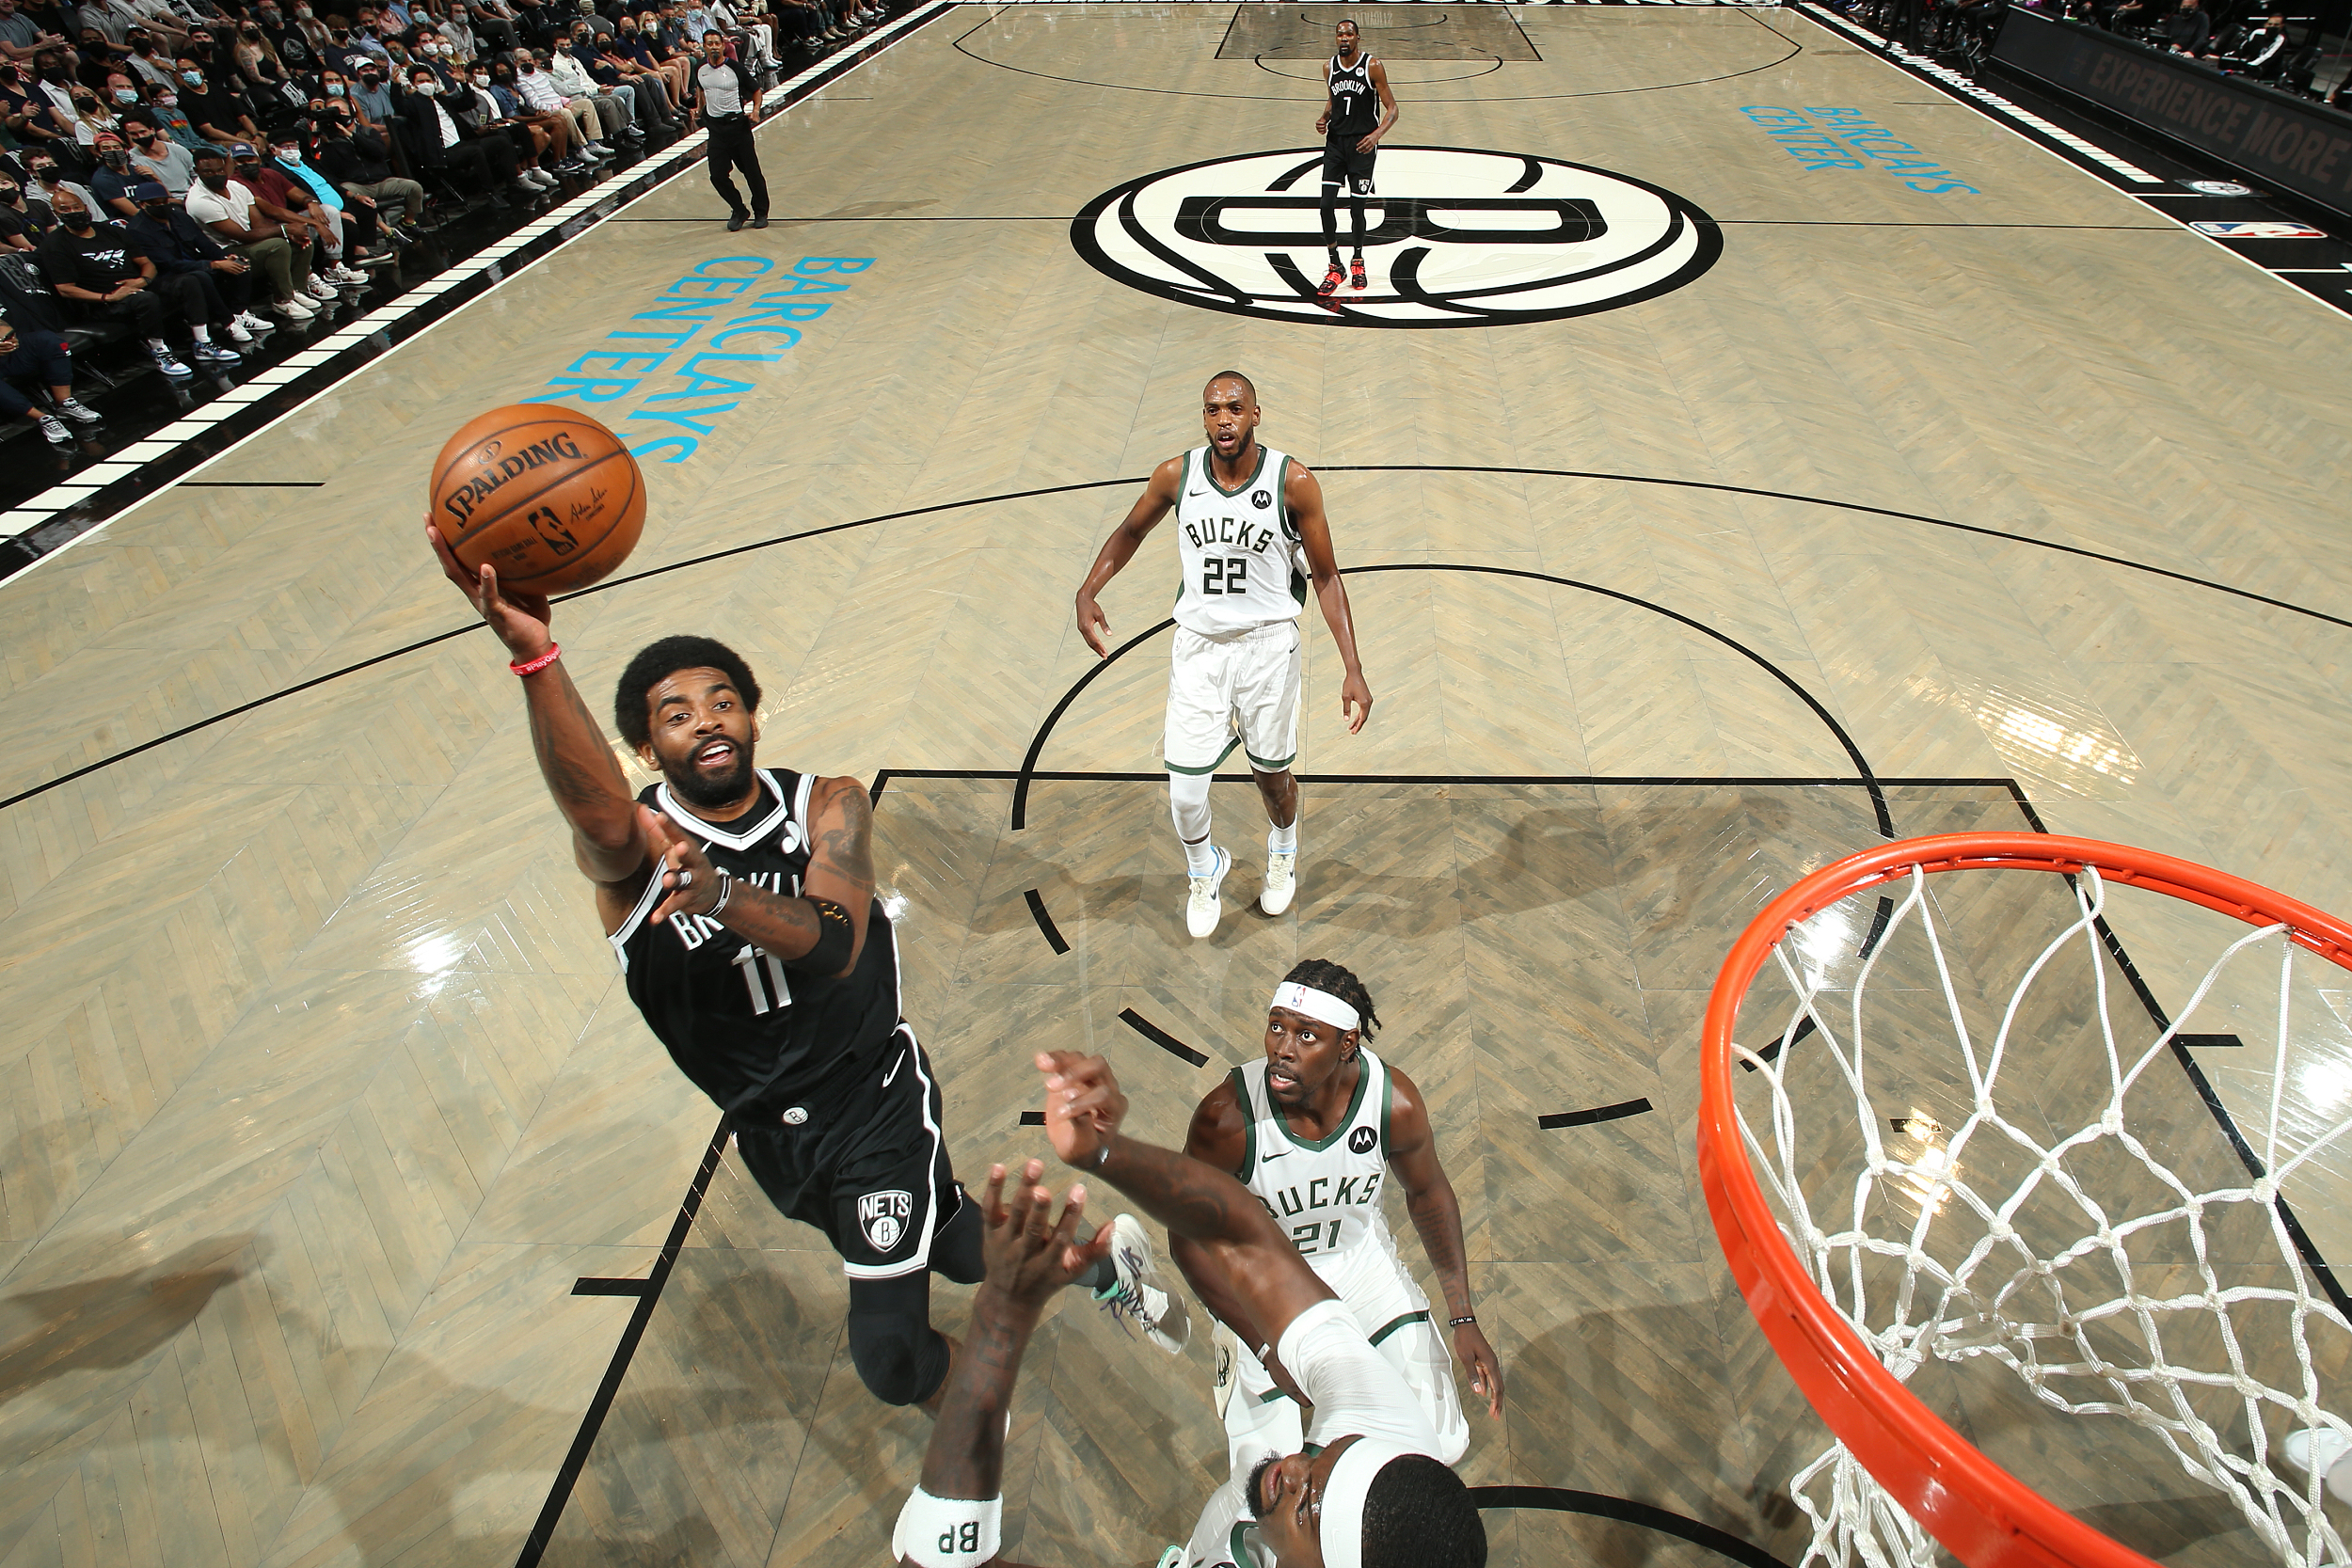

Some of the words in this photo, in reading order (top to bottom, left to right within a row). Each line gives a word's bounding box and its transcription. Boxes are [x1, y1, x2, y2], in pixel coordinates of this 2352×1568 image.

[1331, 79, 1366, 96] BROOKLYN
[1343, 96, 1352, 116] 7
[2089, 53, 2250, 143] EXPERIENCE
[2239, 111, 2352, 183] MORE
[1739, 105, 1866, 171] CENTER
[1803, 107, 1981, 195] BARCLAYS
[518, 256, 775, 404] CENTER
[445, 432, 584, 530] SPALDING
[1185, 517, 1274, 554] BUCKS
[1203, 557, 1248, 595] 22
[731, 942, 792, 1016] 11
[861, 1193, 910, 1221] NETS
[1291, 1218, 1343, 1255] 21
[939, 1521, 979, 1554] BP
